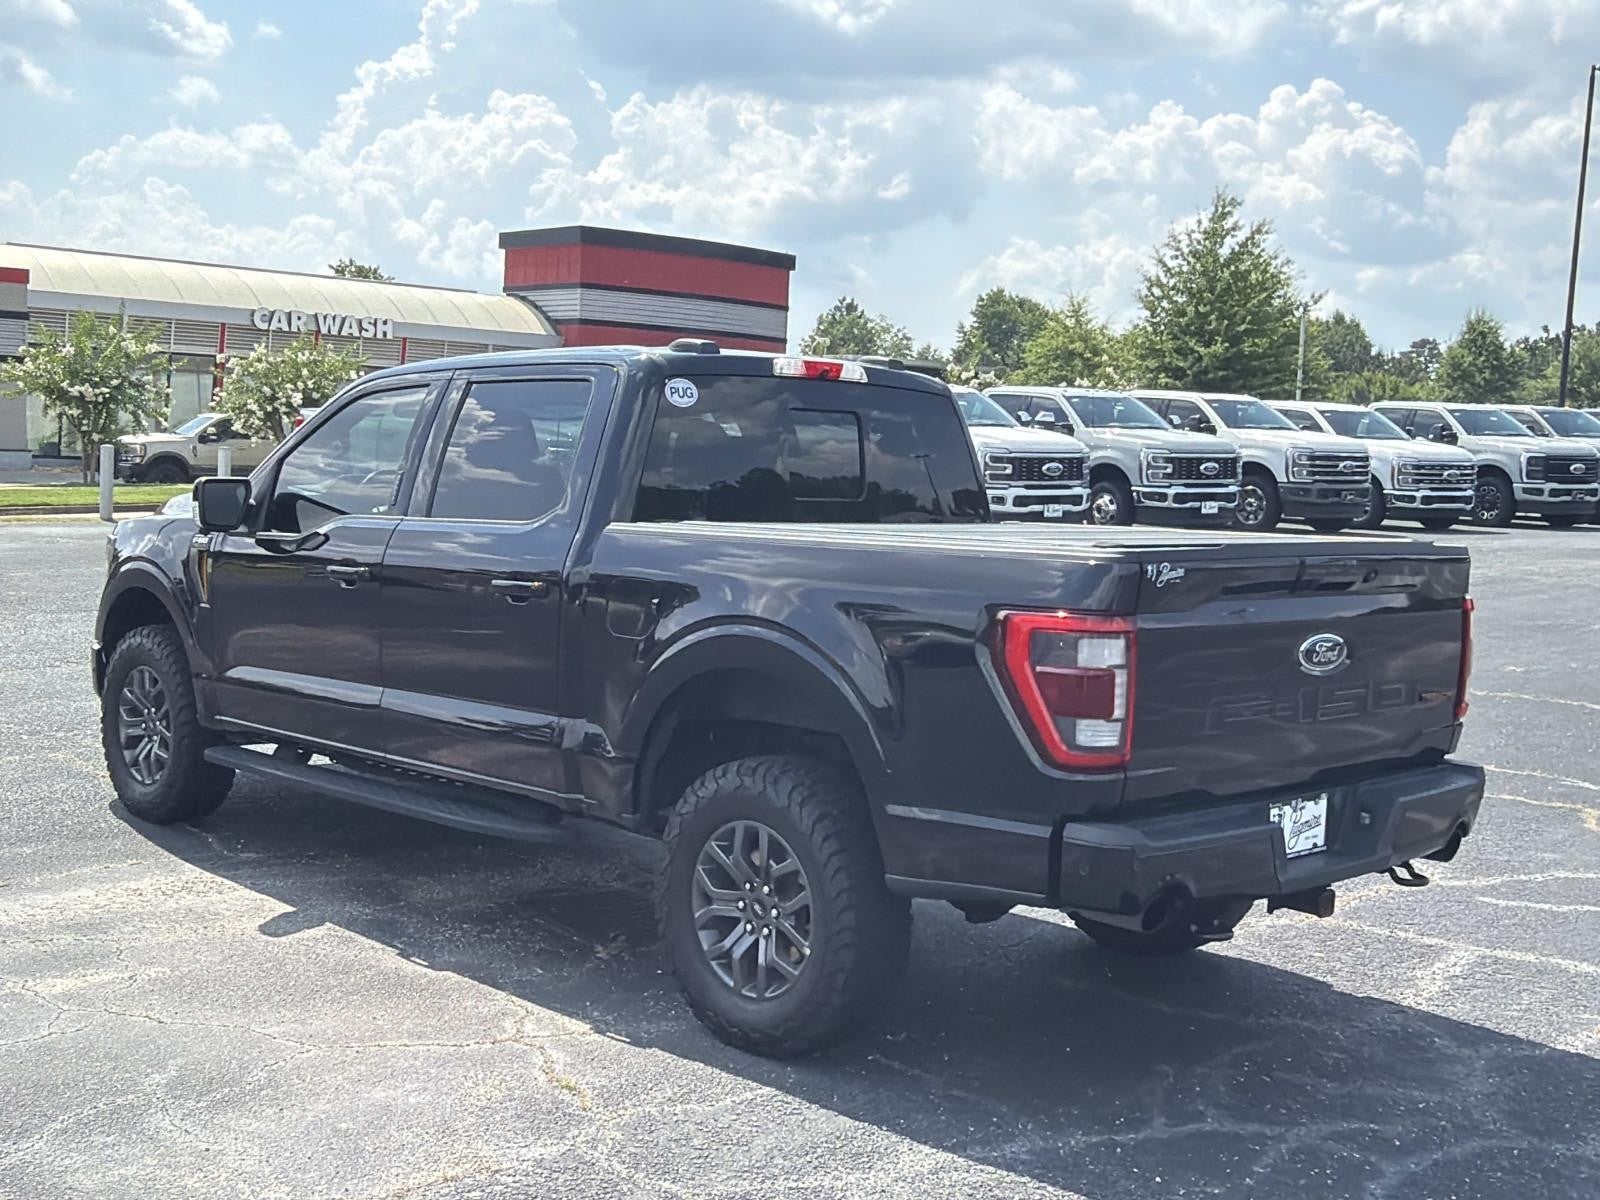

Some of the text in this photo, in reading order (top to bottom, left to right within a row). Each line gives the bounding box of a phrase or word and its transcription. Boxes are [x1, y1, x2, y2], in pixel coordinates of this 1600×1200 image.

[253, 308, 394, 340] CAR WASH
[670, 386, 694, 399] PUG
[1312, 642, 1341, 662] Ford
